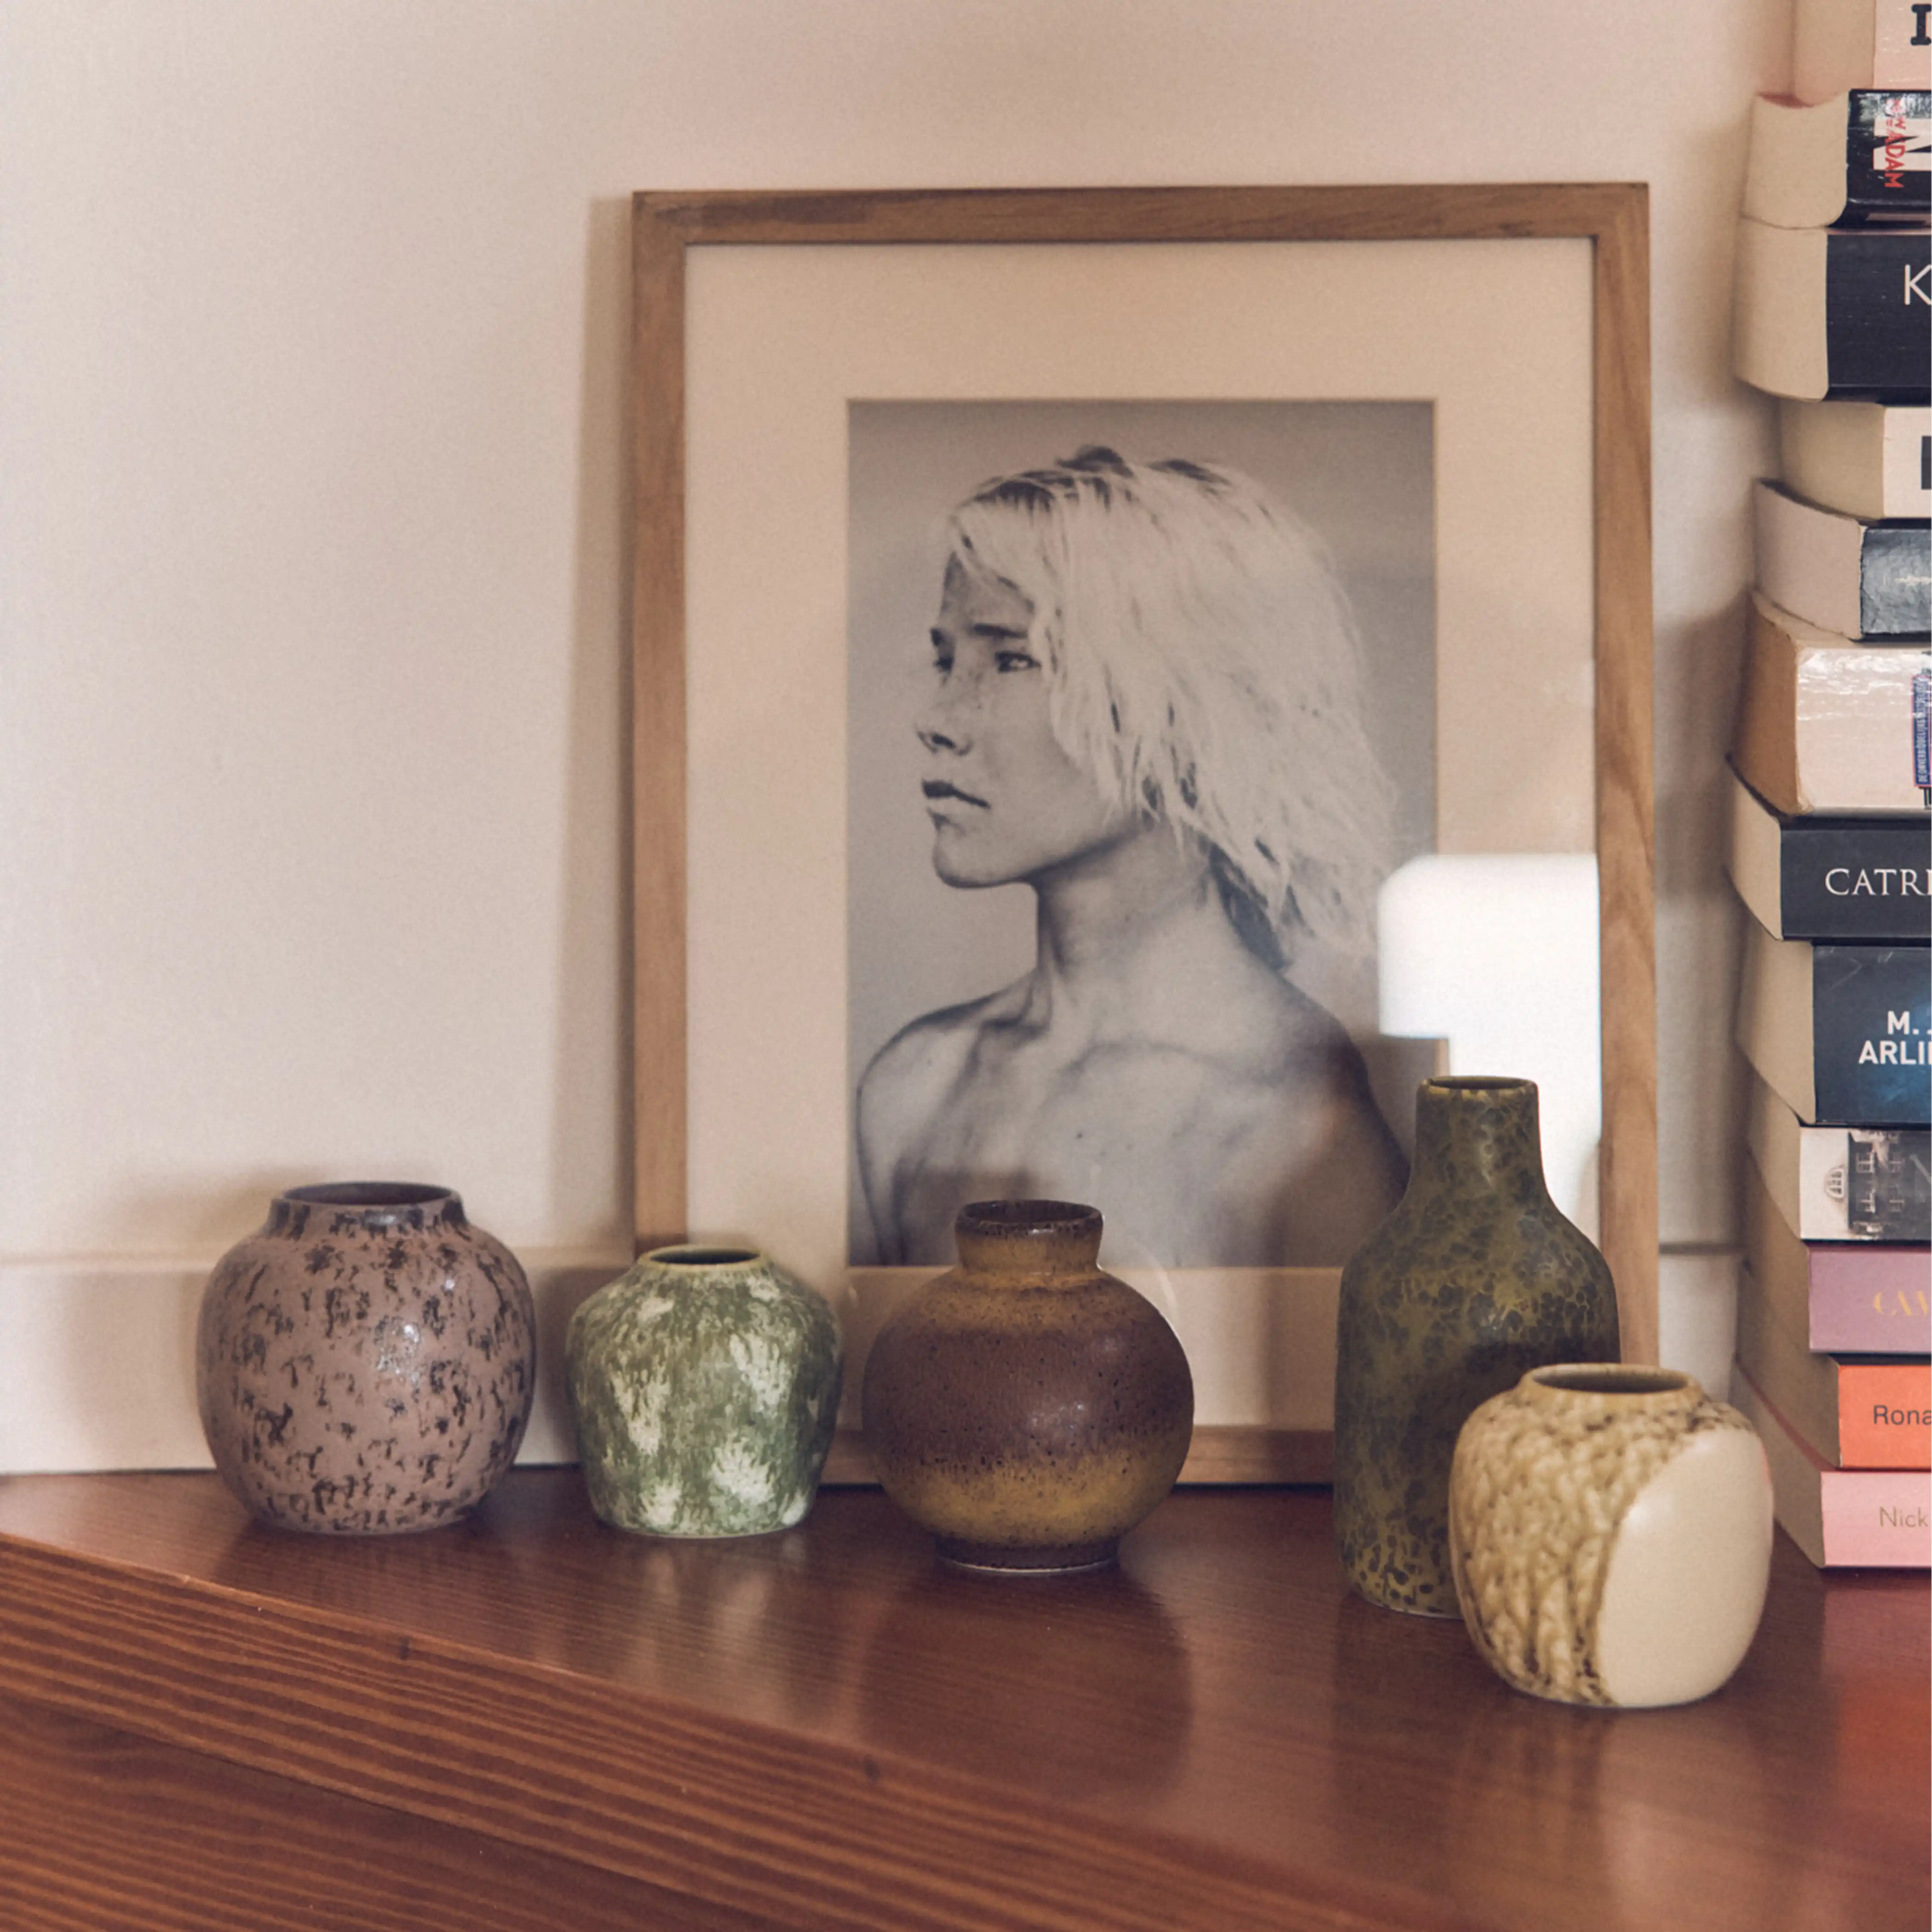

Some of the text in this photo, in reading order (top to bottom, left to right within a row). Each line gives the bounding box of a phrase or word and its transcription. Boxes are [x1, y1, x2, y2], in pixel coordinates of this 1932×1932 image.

[1904, 264, 1932, 305] K
[1887, 1011, 1919, 1035] M.
[1858, 1040, 1932, 1065] ARLI
[1874, 1404, 1932, 1426] Rona
[1880, 1506, 1929, 1528] Nick
